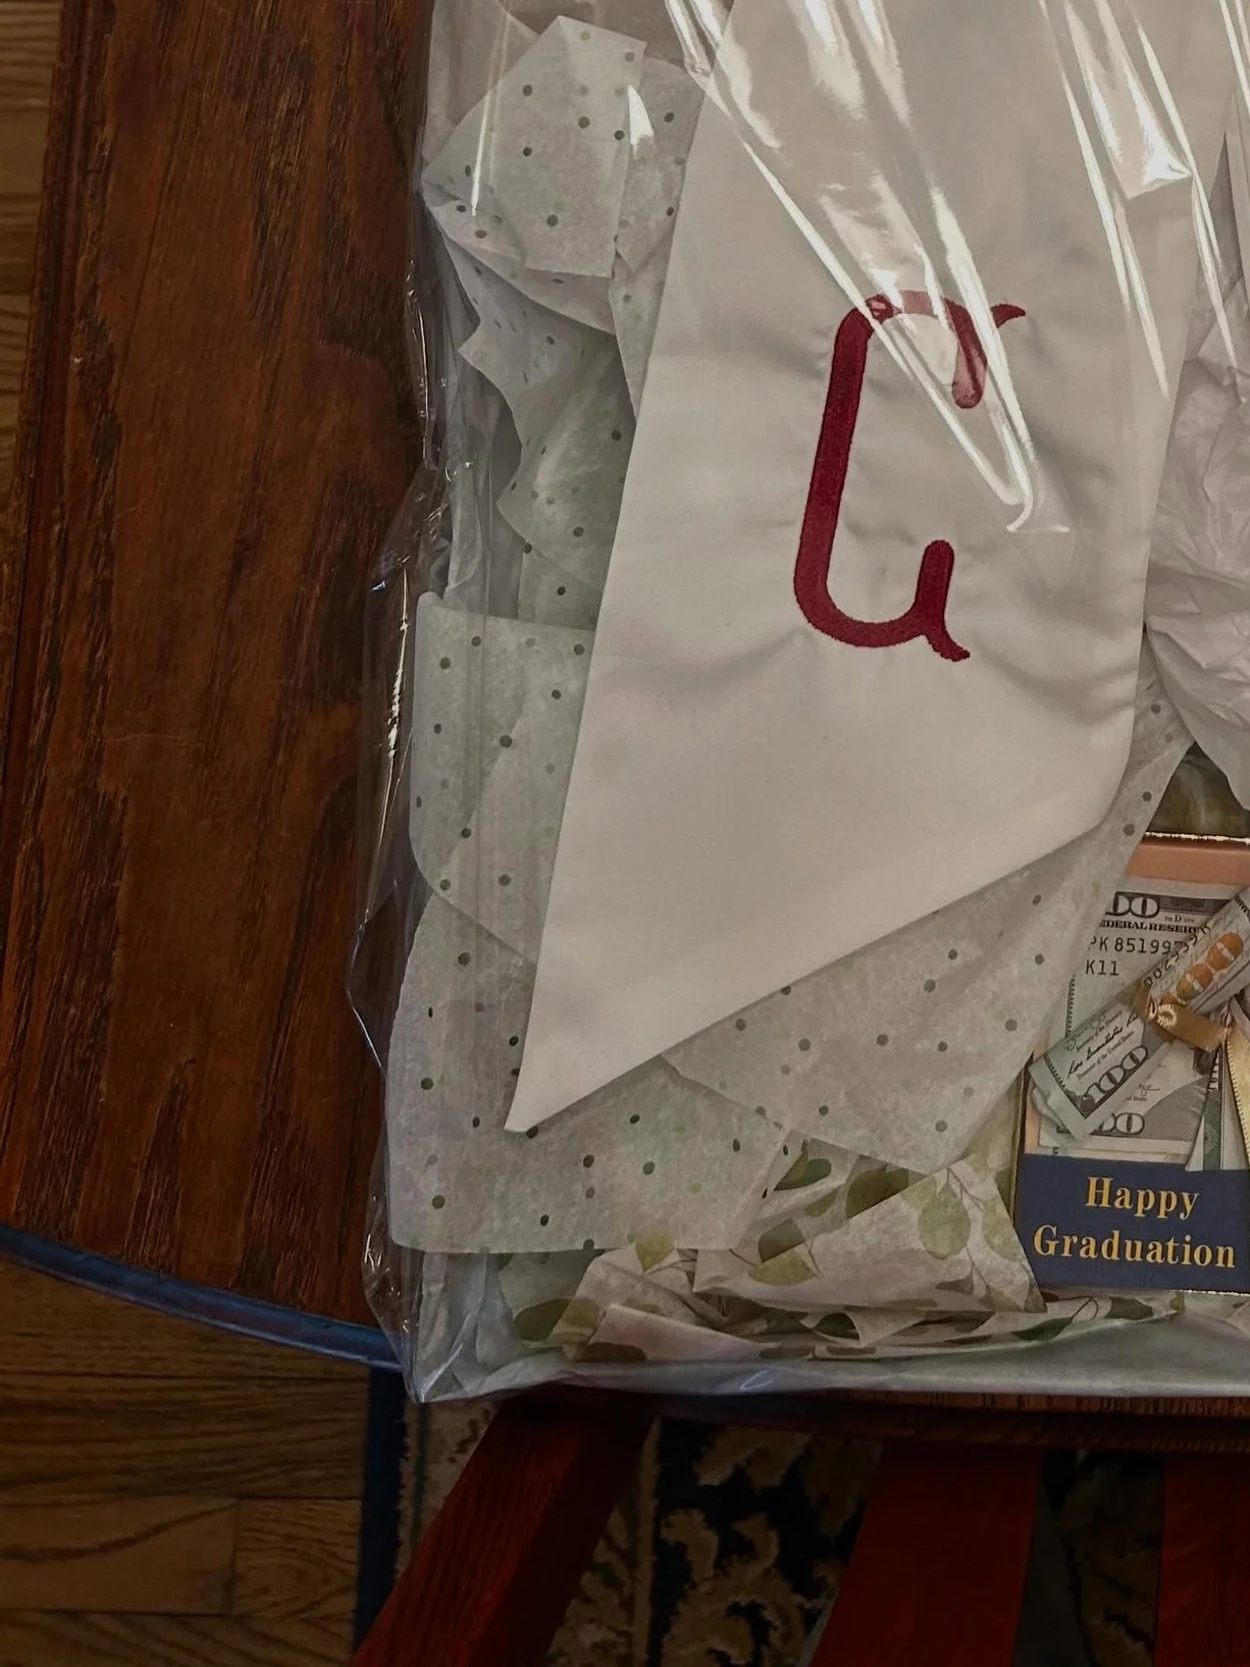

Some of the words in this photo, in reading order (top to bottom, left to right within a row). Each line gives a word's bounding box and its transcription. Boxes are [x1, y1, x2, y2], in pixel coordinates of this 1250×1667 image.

[1085, 959, 1119, 976] K11
[1083, 1045, 1150, 1104] 100
[1086, 1175, 1200, 1221] Happy
[1033, 1223, 1237, 1270] Graduation
